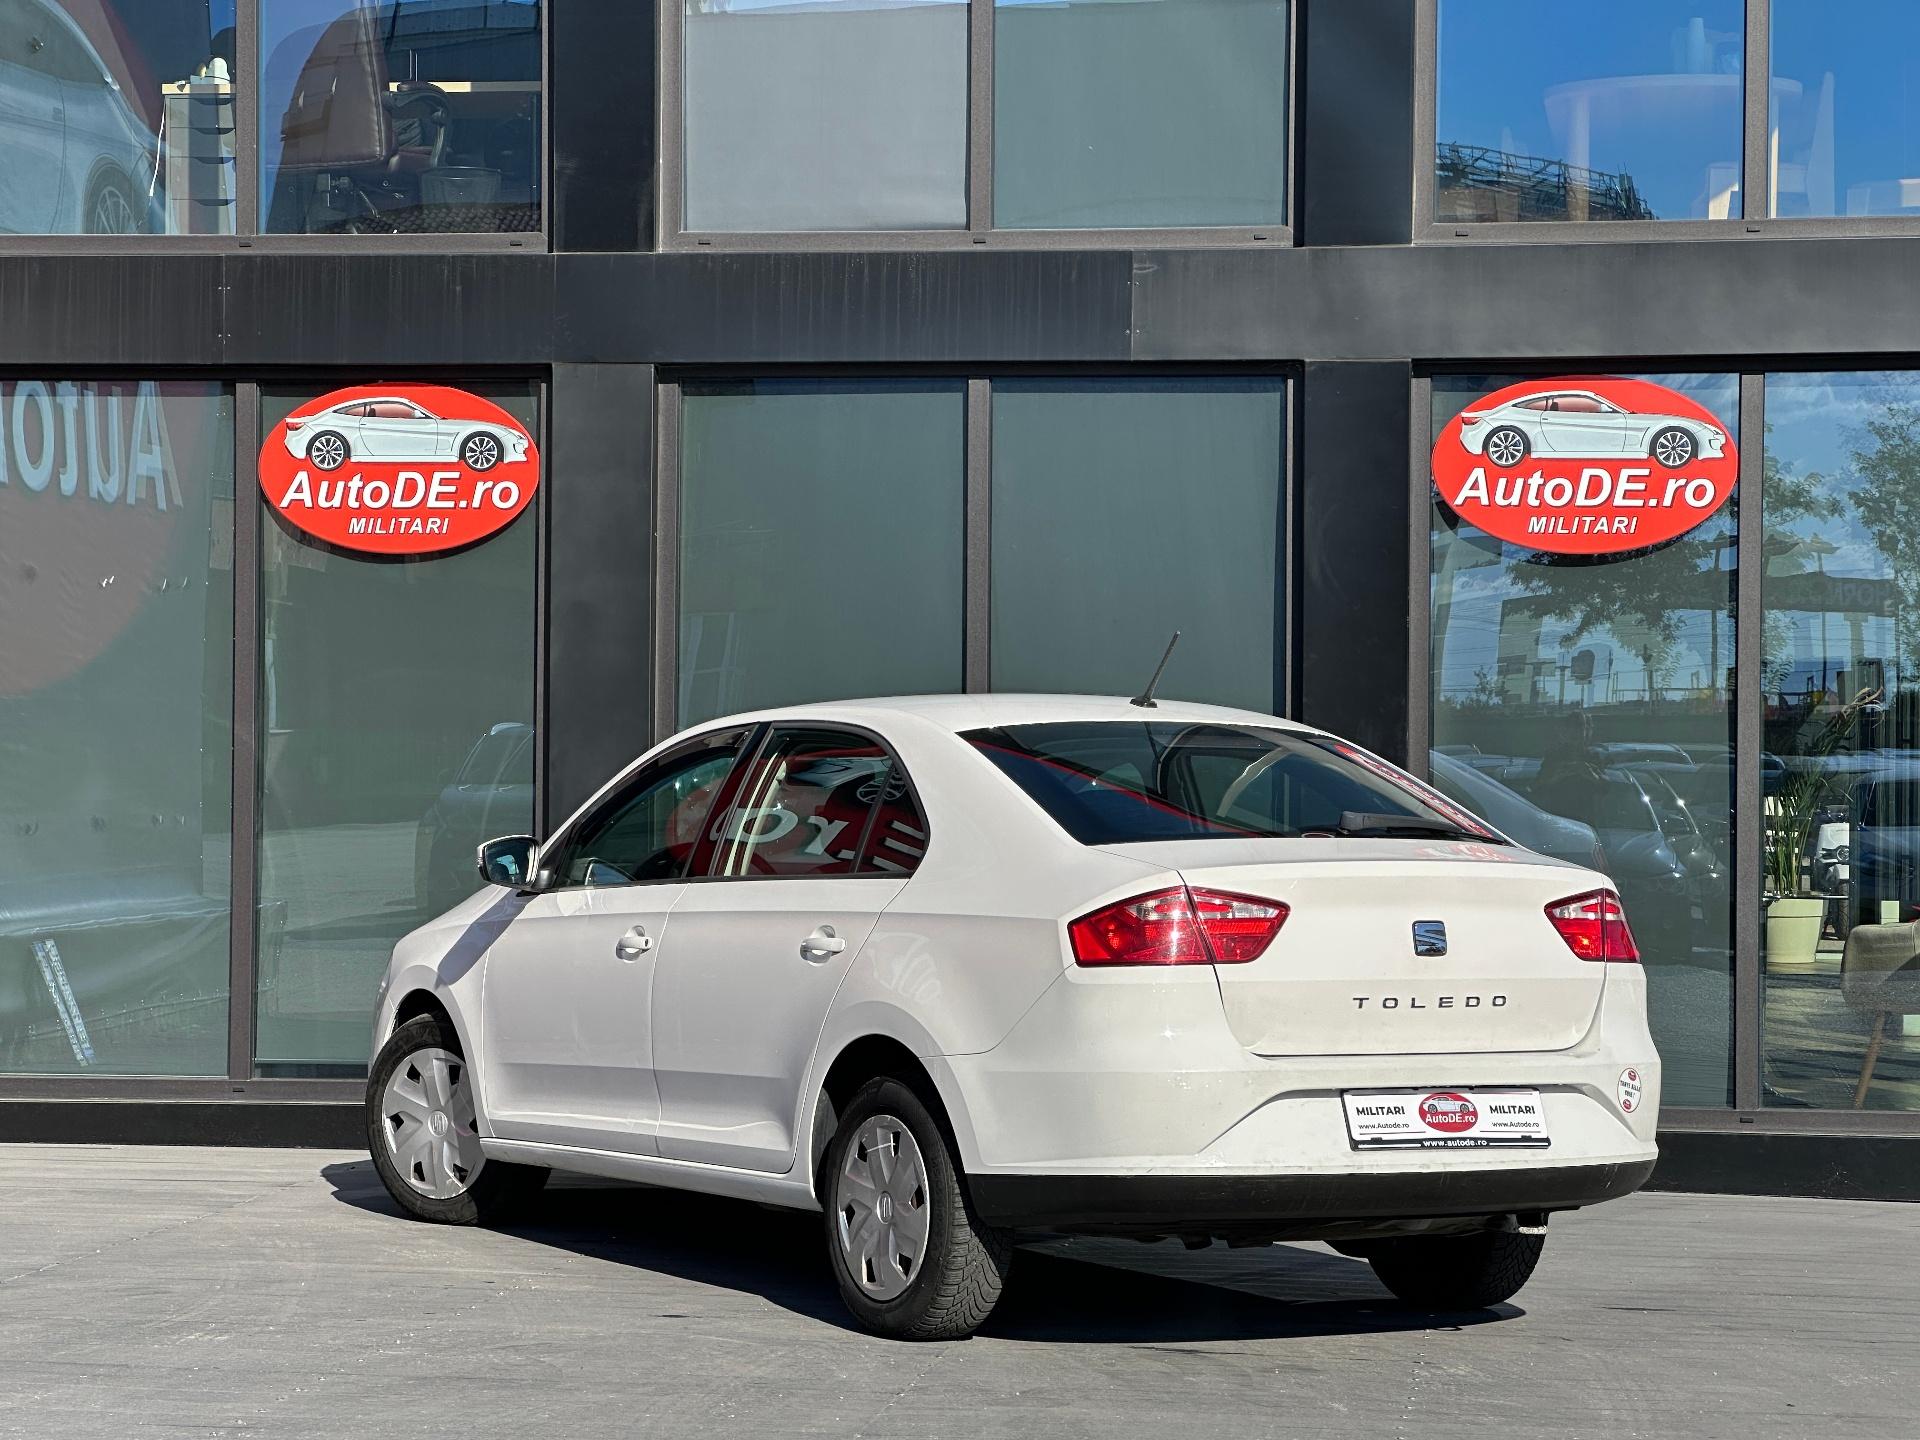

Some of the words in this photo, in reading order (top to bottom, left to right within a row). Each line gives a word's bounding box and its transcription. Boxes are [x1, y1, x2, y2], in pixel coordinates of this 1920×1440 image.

[279, 471, 521, 509] AutoDE.ro
[1453, 466, 1716, 508] AutoDE.ro
[348, 517, 449, 535] MILITARI
[1527, 516, 1638, 535] MILITARI
[1353, 995, 1507, 1009] TOLEDO
[1355, 1106, 1406, 1116] MILITARI
[1489, 1105, 1536, 1115] MILITARI
[1425, 1113, 1476, 1124] AutoDE.ro
[1358, 1122, 1410, 1130] www.Autode.ro
[1422, 1138, 1488, 1147] www.autode.ro
